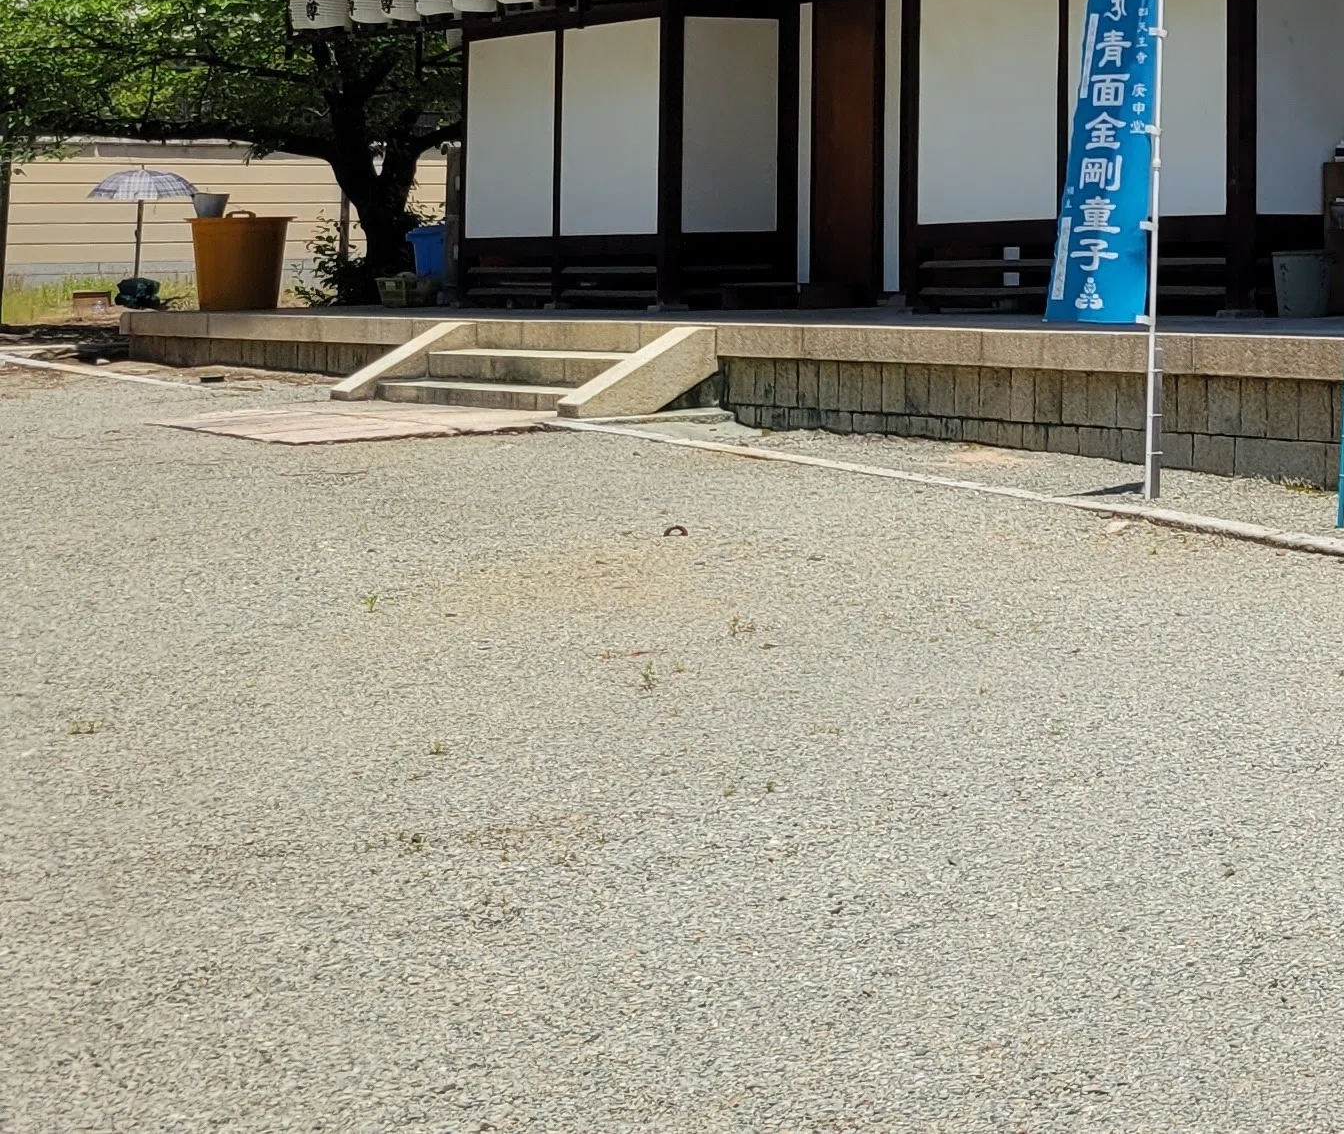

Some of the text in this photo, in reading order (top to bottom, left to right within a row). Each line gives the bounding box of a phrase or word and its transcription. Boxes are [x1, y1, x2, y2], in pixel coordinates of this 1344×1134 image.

[1070, 30, 1132, 271] 青面金剛童子
